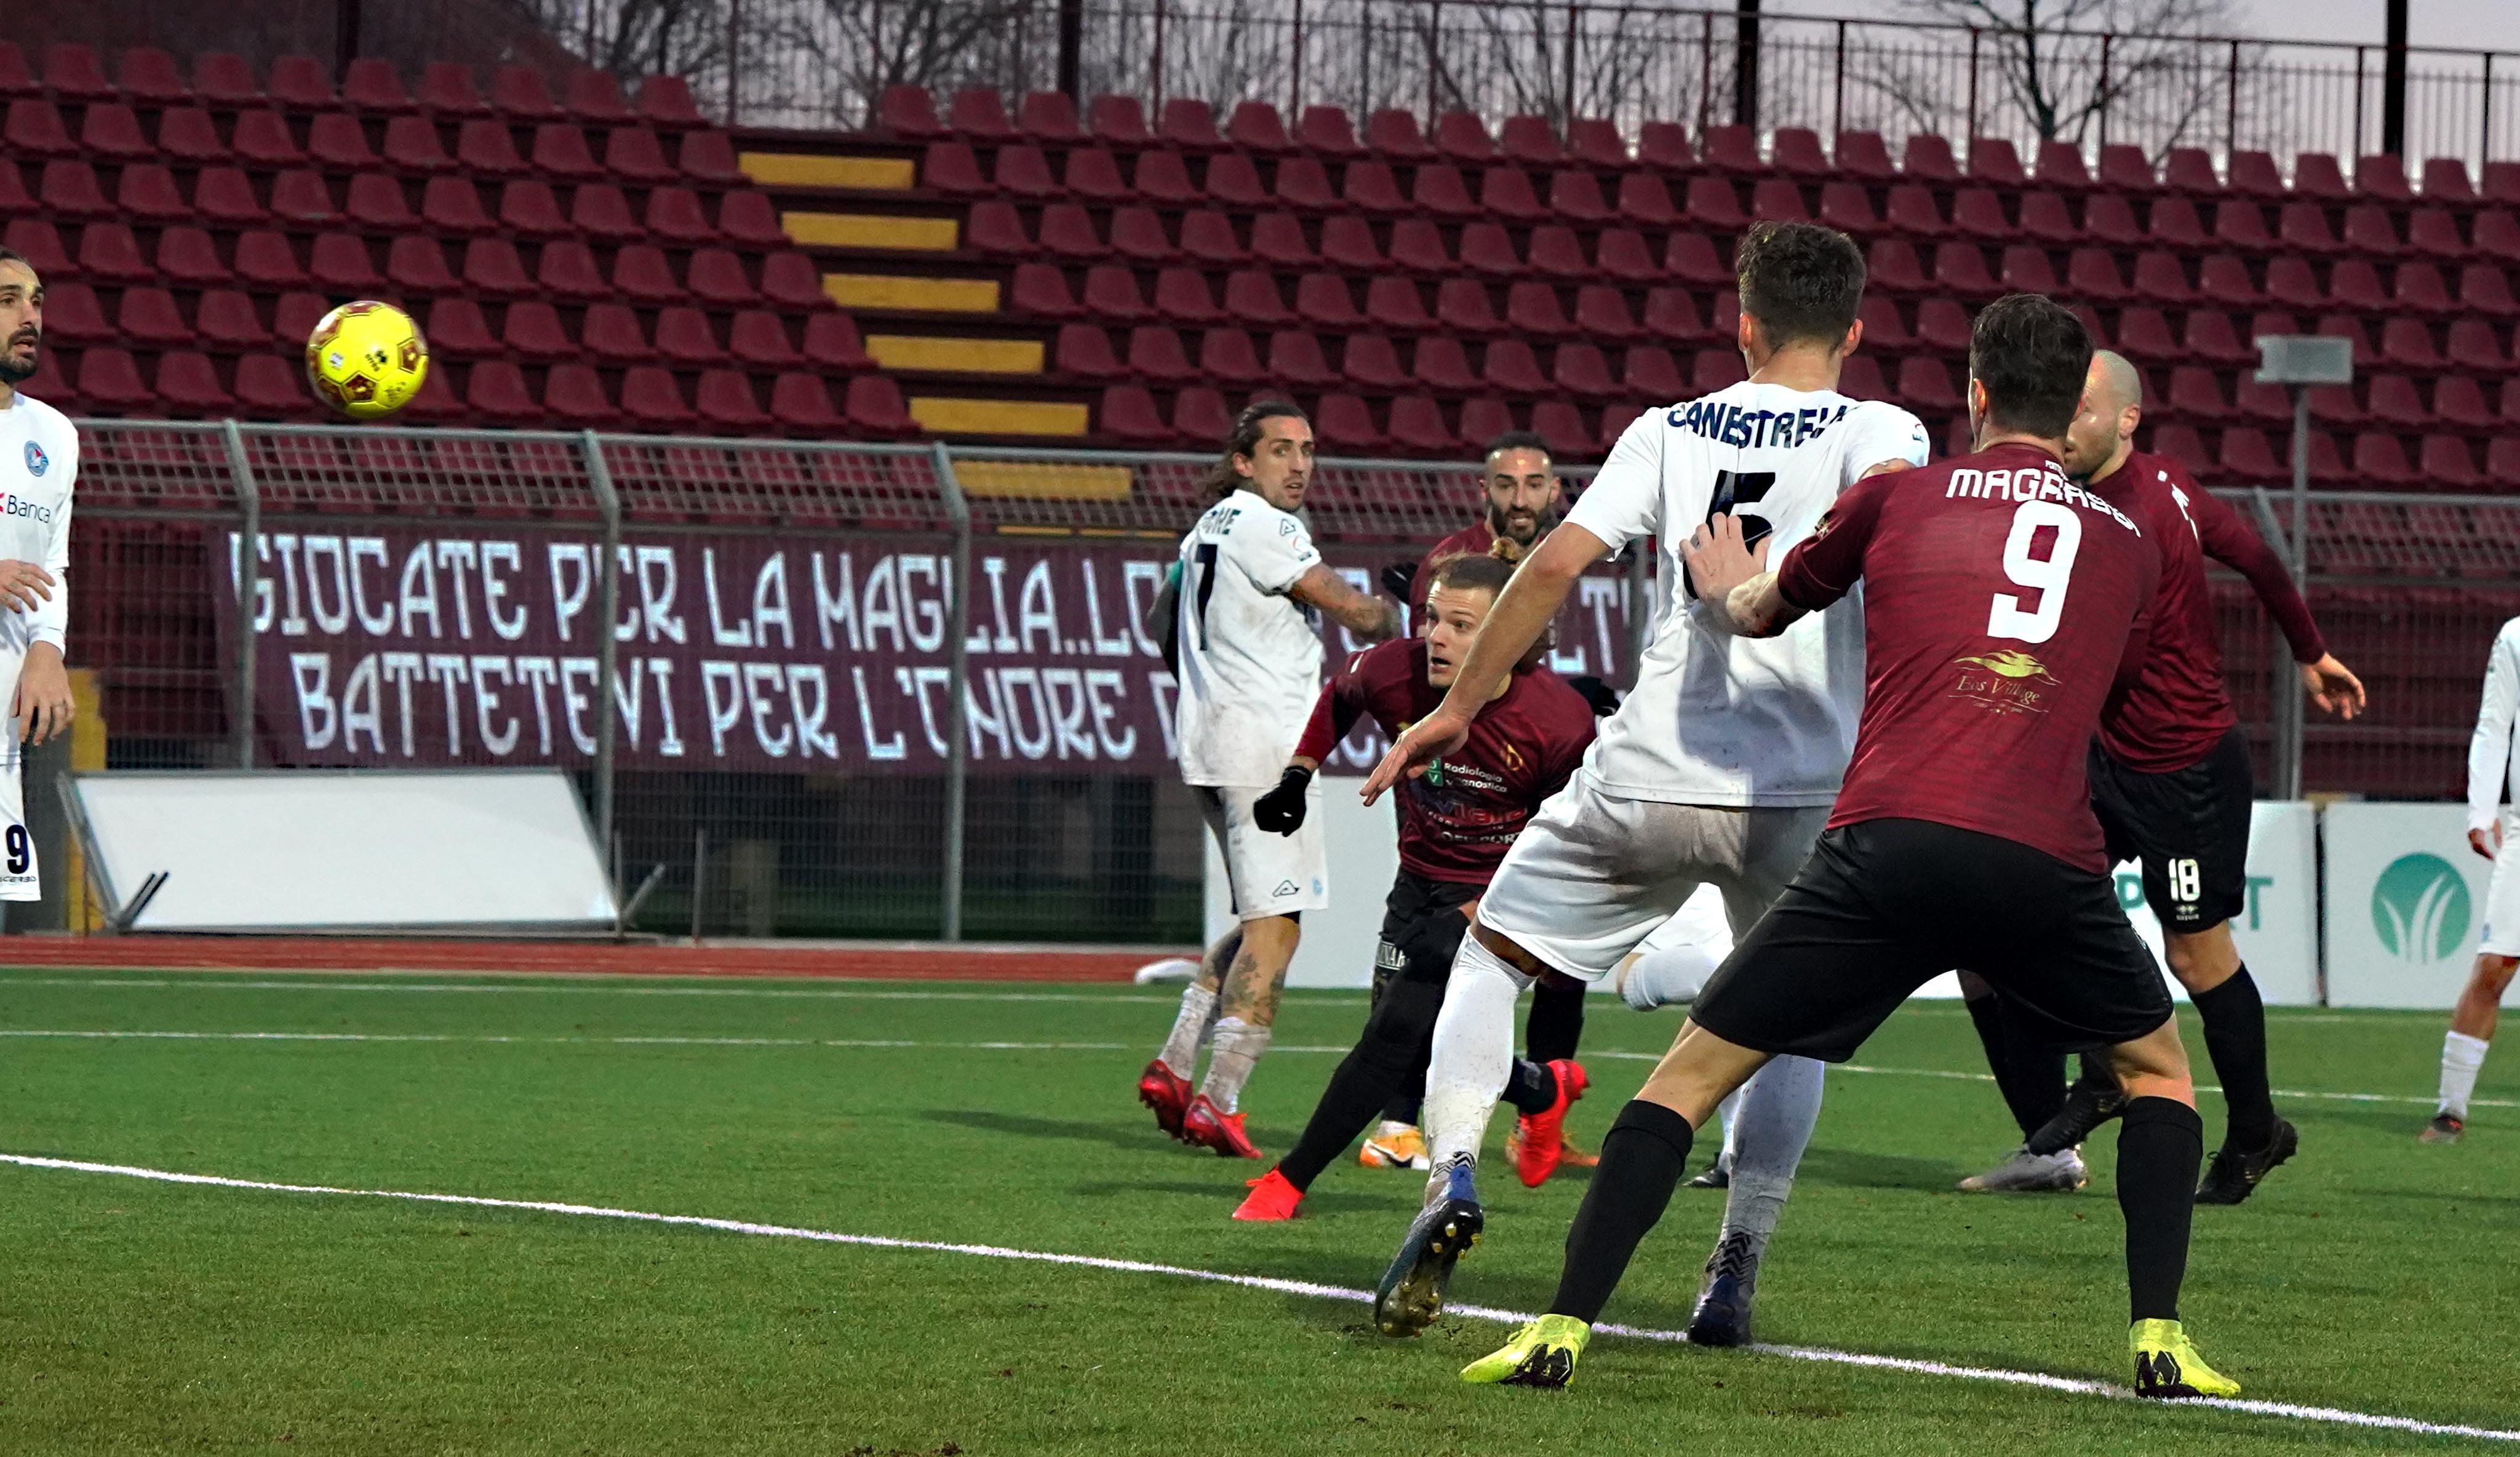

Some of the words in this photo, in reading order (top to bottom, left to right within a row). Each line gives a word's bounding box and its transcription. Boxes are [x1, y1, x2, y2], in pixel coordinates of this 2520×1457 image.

[7, 494, 51, 524] Banca
[1683, 469, 1776, 601] 5
[228, 531, 527, 640] GIOCATE
[703, 546, 794, 650] LA
[1987, 499, 2082, 644] 9
[289, 652, 685, 758] BATTETEVI
[701, 660, 840, 760] PER
[851, 665, 1138, 761] L'ONORE
[1443, 762, 1503, 783] Radiologia
[6, 824, 30, 874] 9
[2168, 858, 2201, 903] 18
